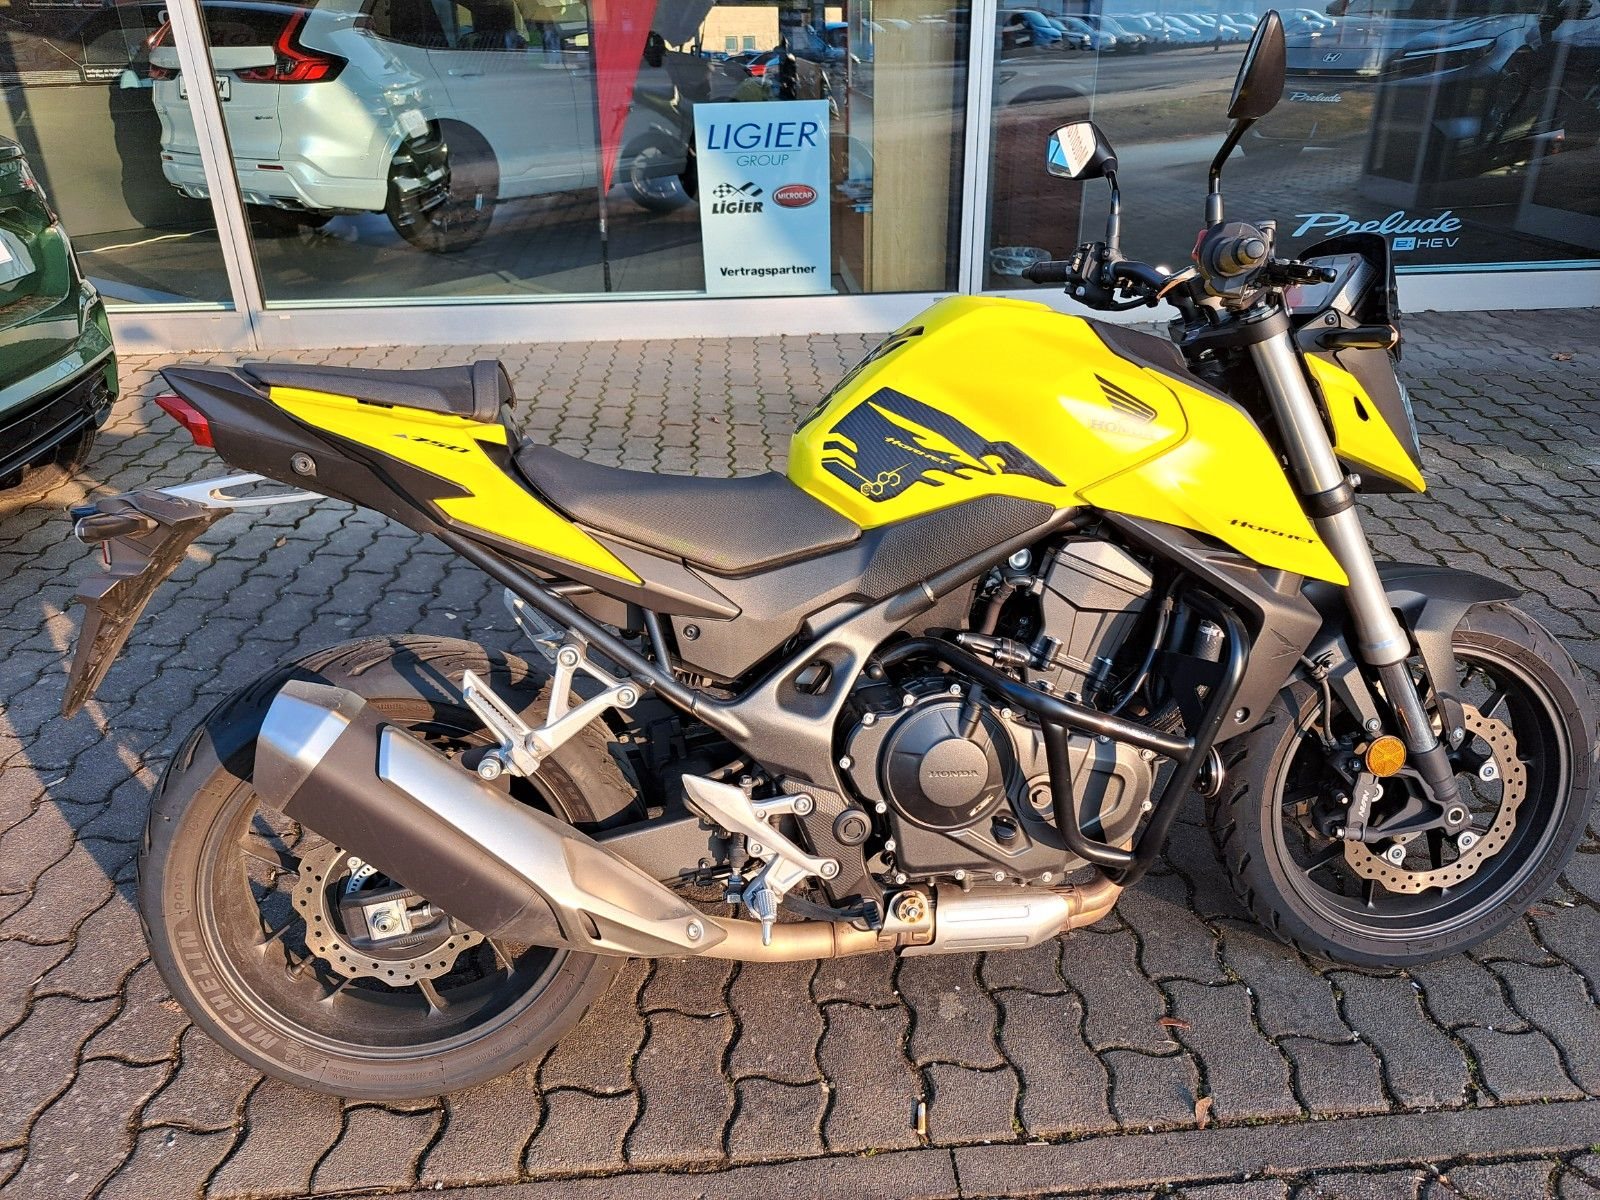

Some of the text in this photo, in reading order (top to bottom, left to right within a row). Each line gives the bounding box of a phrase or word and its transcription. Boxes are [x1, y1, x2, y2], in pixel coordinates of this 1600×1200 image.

[1289, 91, 1342, 103] Prelude
[707, 121, 819, 150] LIGIER
[736, 154, 790, 167] GROUP
[777, 189, 814, 201] MICROCAR
[1291, 210, 1464, 237] Prelude
[719, 264, 817, 279] Vertragspartner
[928, 770, 979, 778] HONDA
[174, 872, 187, 911] ROAD
[178, 930, 281, 1050] MICHELIN
